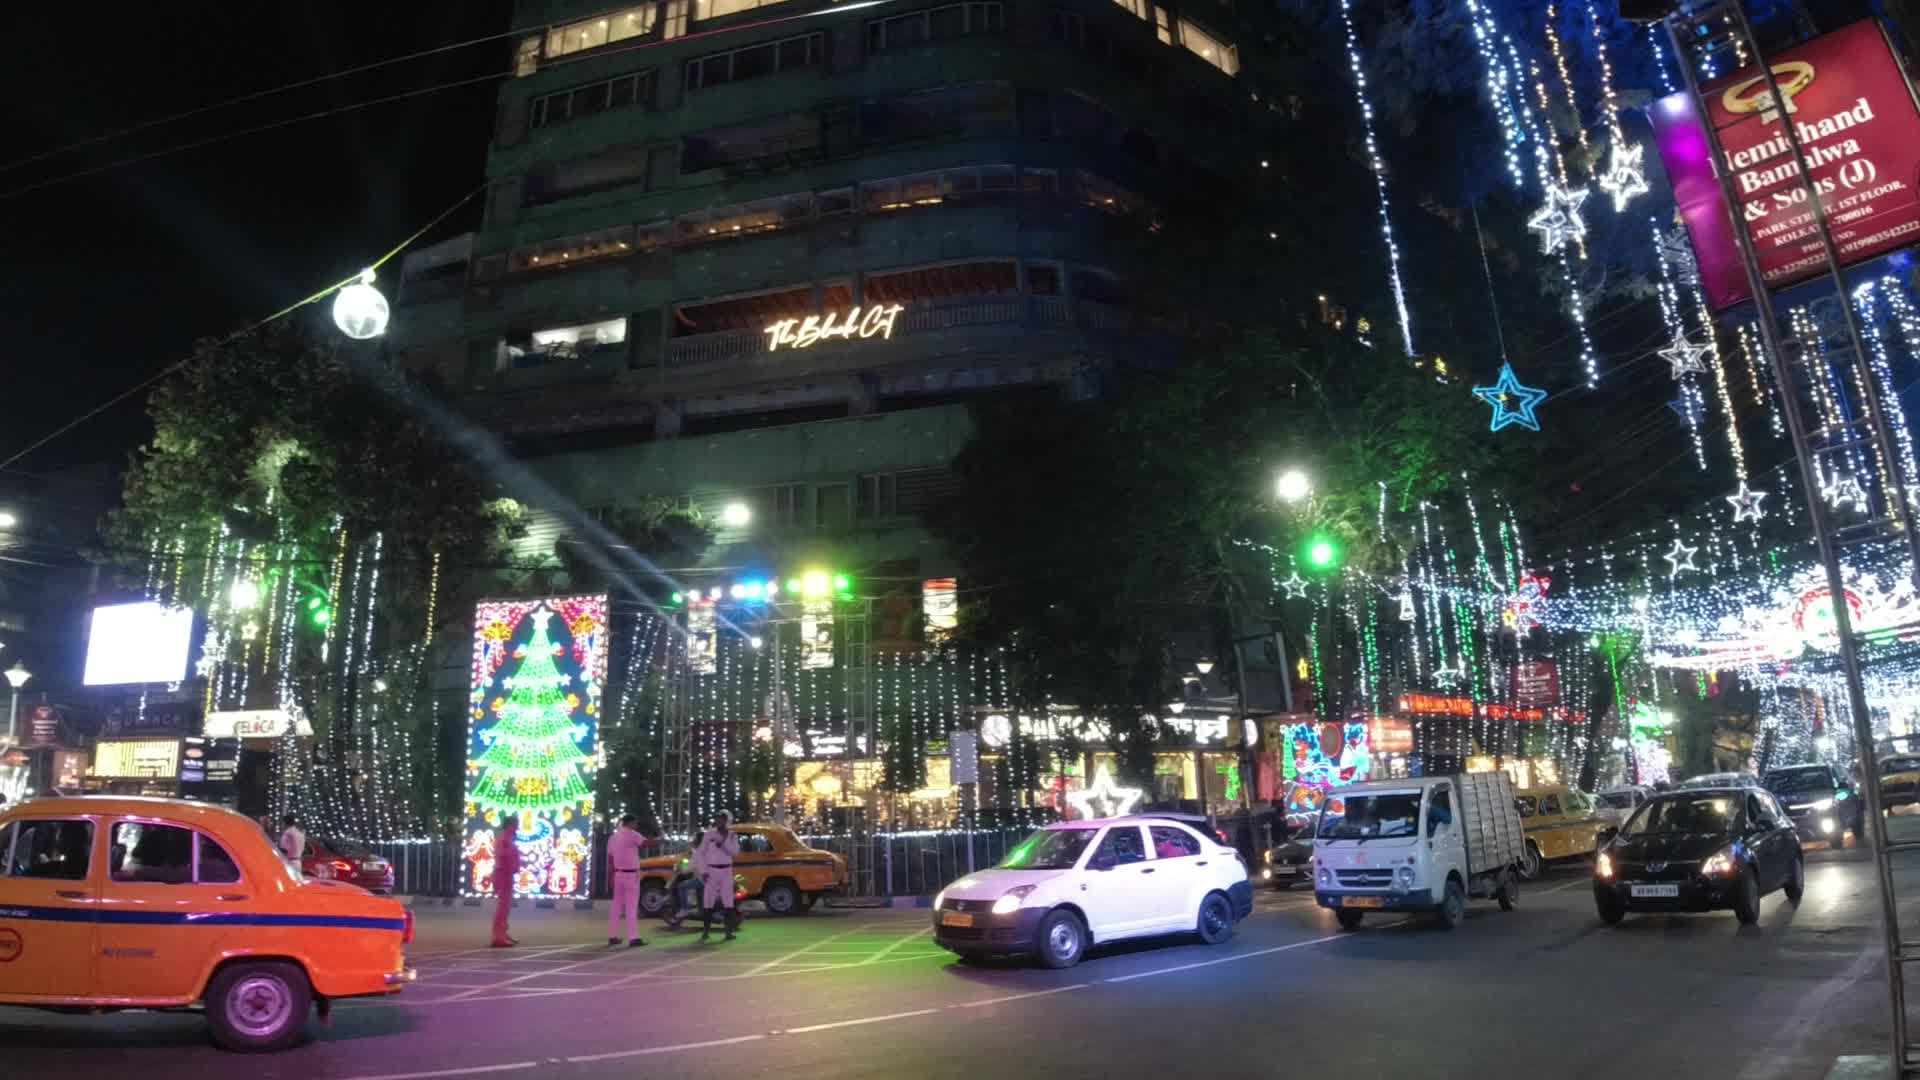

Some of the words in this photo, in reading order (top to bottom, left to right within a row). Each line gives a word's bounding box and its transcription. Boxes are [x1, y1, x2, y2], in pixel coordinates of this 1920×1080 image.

[1743, 200, 1769, 222] &
[1839, 158, 1877, 190] (J)
[1757, 220, 1788, 239] PARK
